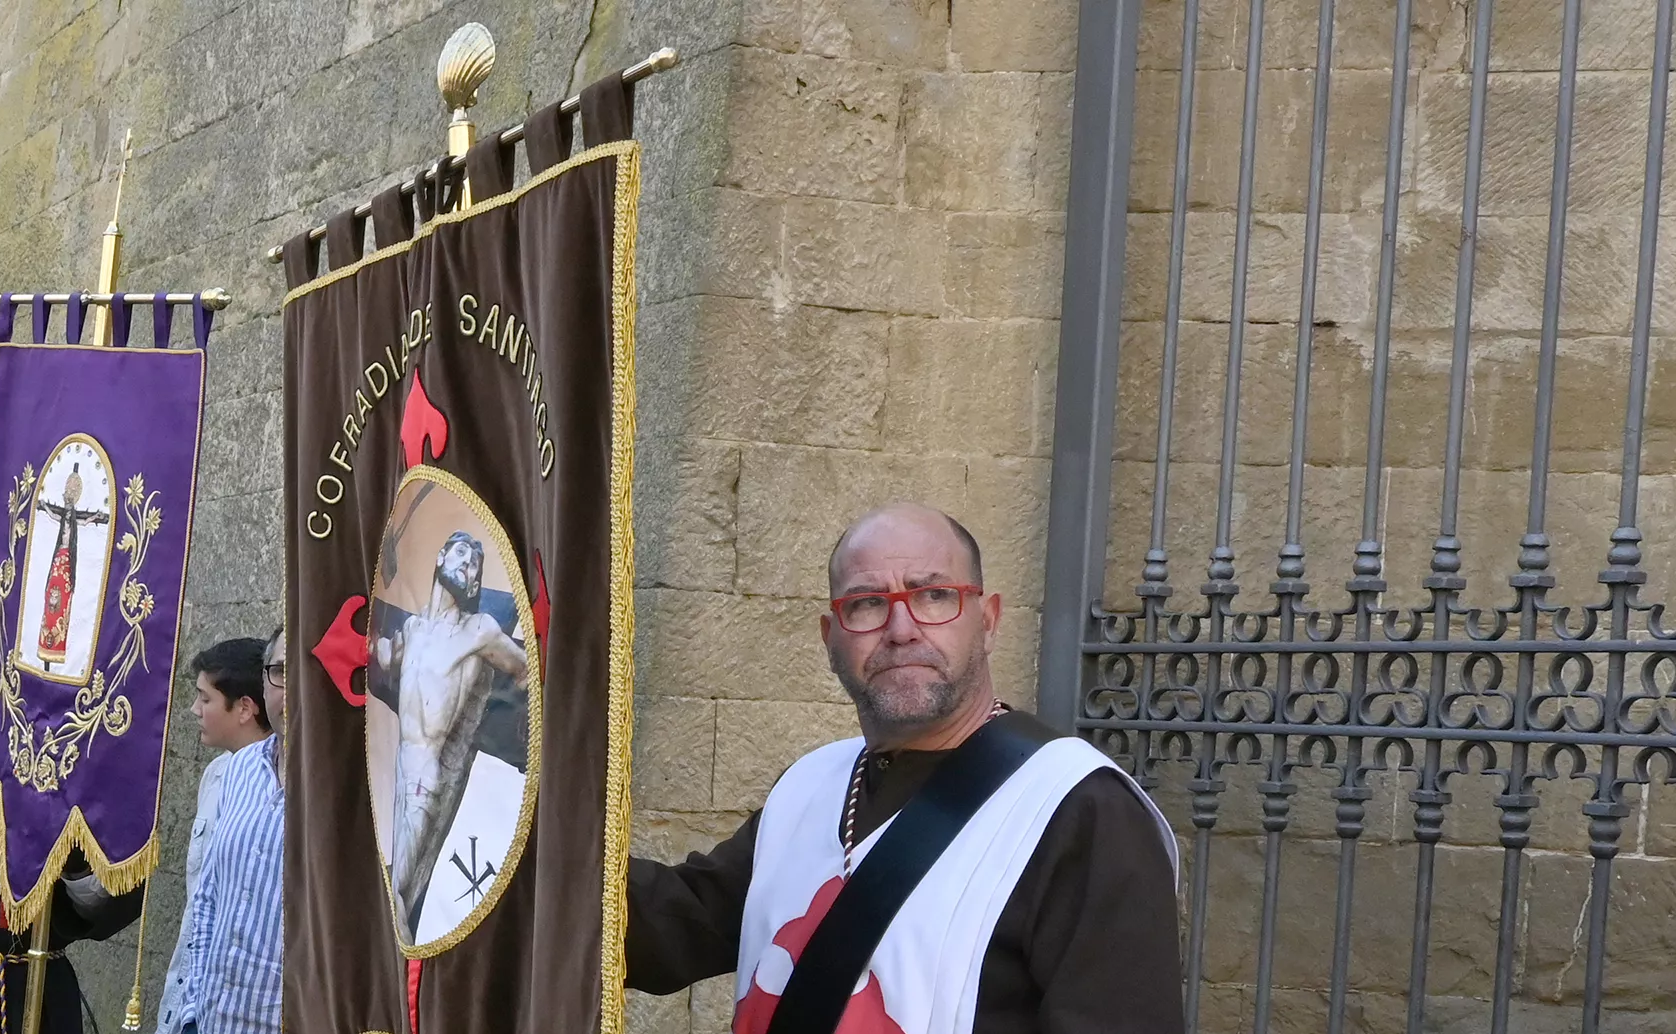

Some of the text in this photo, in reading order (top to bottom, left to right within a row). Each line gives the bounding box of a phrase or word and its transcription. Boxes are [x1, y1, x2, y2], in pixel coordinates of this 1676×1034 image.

[307, 294, 555, 538] COFRADIA DE SANTIAGO
